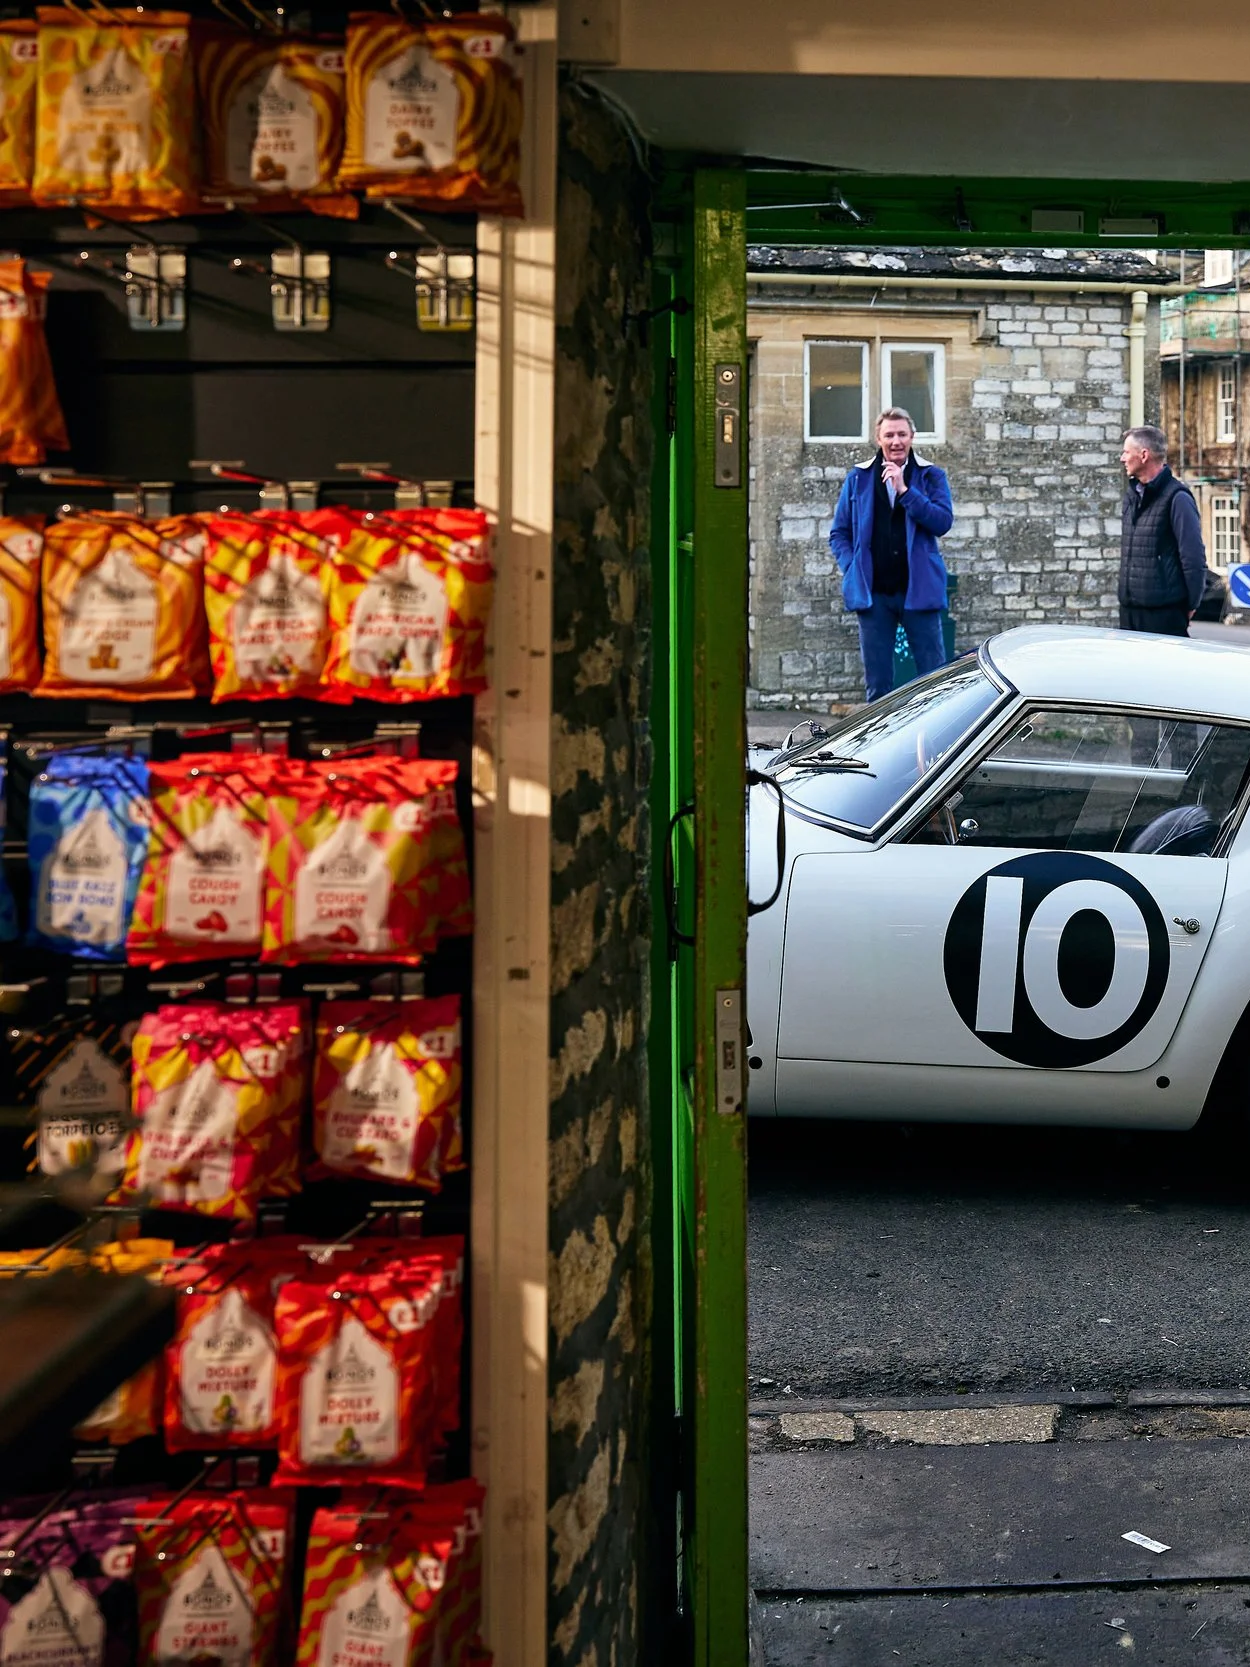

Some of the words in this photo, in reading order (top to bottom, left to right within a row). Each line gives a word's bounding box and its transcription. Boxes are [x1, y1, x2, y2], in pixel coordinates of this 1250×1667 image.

[389, 104, 433, 115] DAIRY
[386, 117, 436, 130] TOFFEE
[365, 612, 436, 626] AMERICAN
[188, 877, 241, 890] COUGH
[188, 891, 238, 906] CANDY
[314, 891, 368, 905] COUGH
[317, 905, 365, 920] CANDY
[975, 876, 1149, 1040] 10
[206, 1366, 250, 1378] DOLLY
[197, 1379, 257, 1393] MIXTURE
[327, 1397, 373, 1410] DOLLY
[318, 1411, 381, 1425] MIXTURE
[184, 1620, 229, 1634] GIANT
[345, 1641, 384, 1656] GIANT
